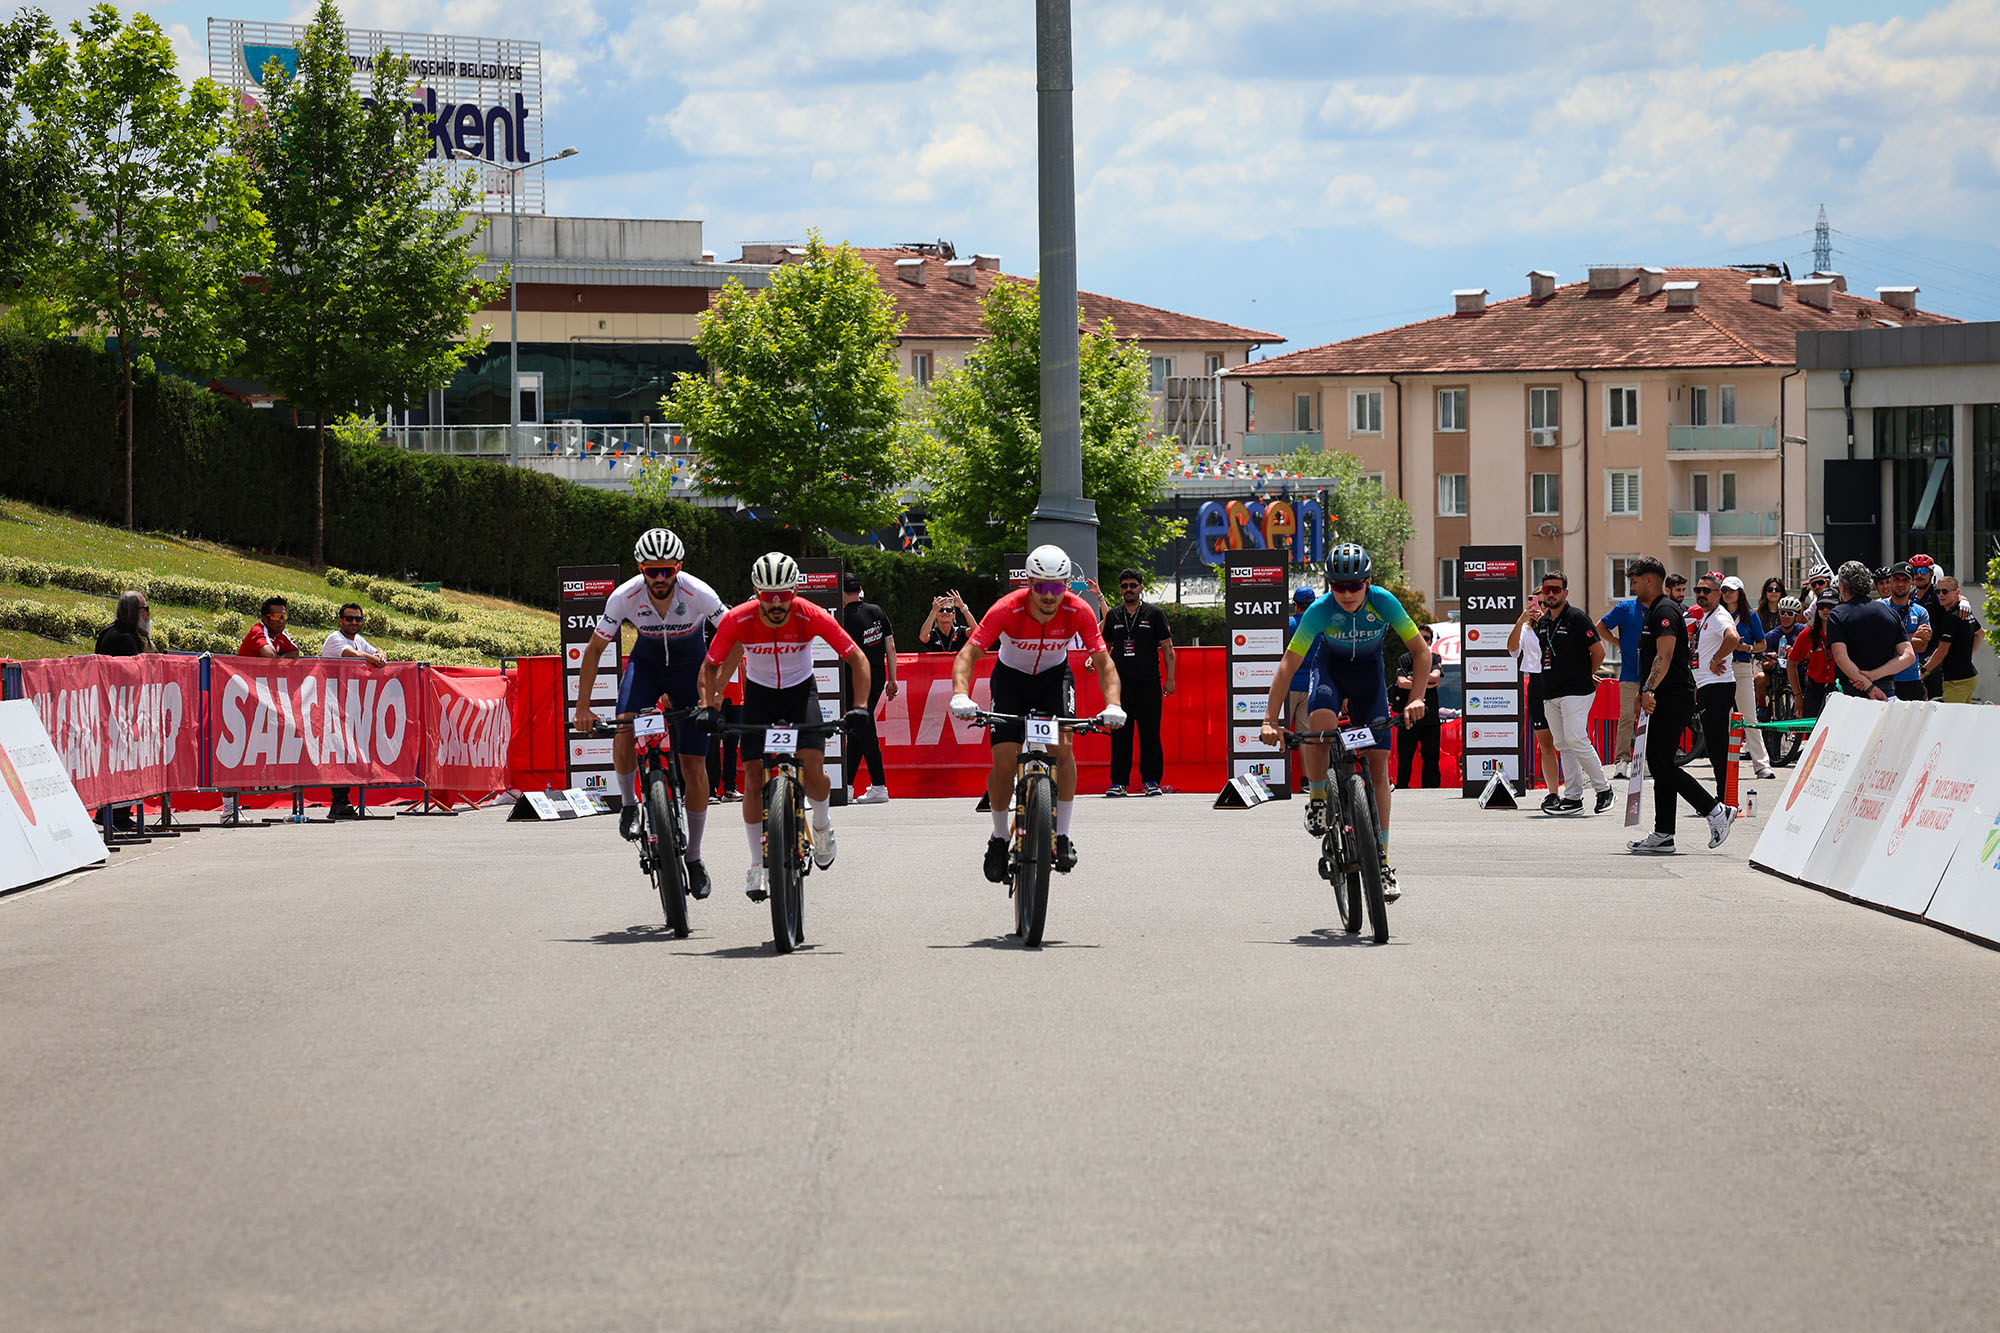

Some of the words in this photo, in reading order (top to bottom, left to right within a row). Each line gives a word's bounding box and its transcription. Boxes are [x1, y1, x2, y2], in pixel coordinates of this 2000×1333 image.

[797, 575, 806, 583] CI
[567, 582, 584, 590] UCI
[1233, 601, 1282, 615] START
[1467, 596, 1516, 609] START
[567, 615, 605, 628] STA
[216, 674, 407, 770] SALCANO
[644, 719, 653, 728] 7
[437, 693, 512, 768] SALCANO
[1034, 724, 1050, 735] 10
[772, 733, 791, 744] 23
[1347, 731, 1367, 742] 26
